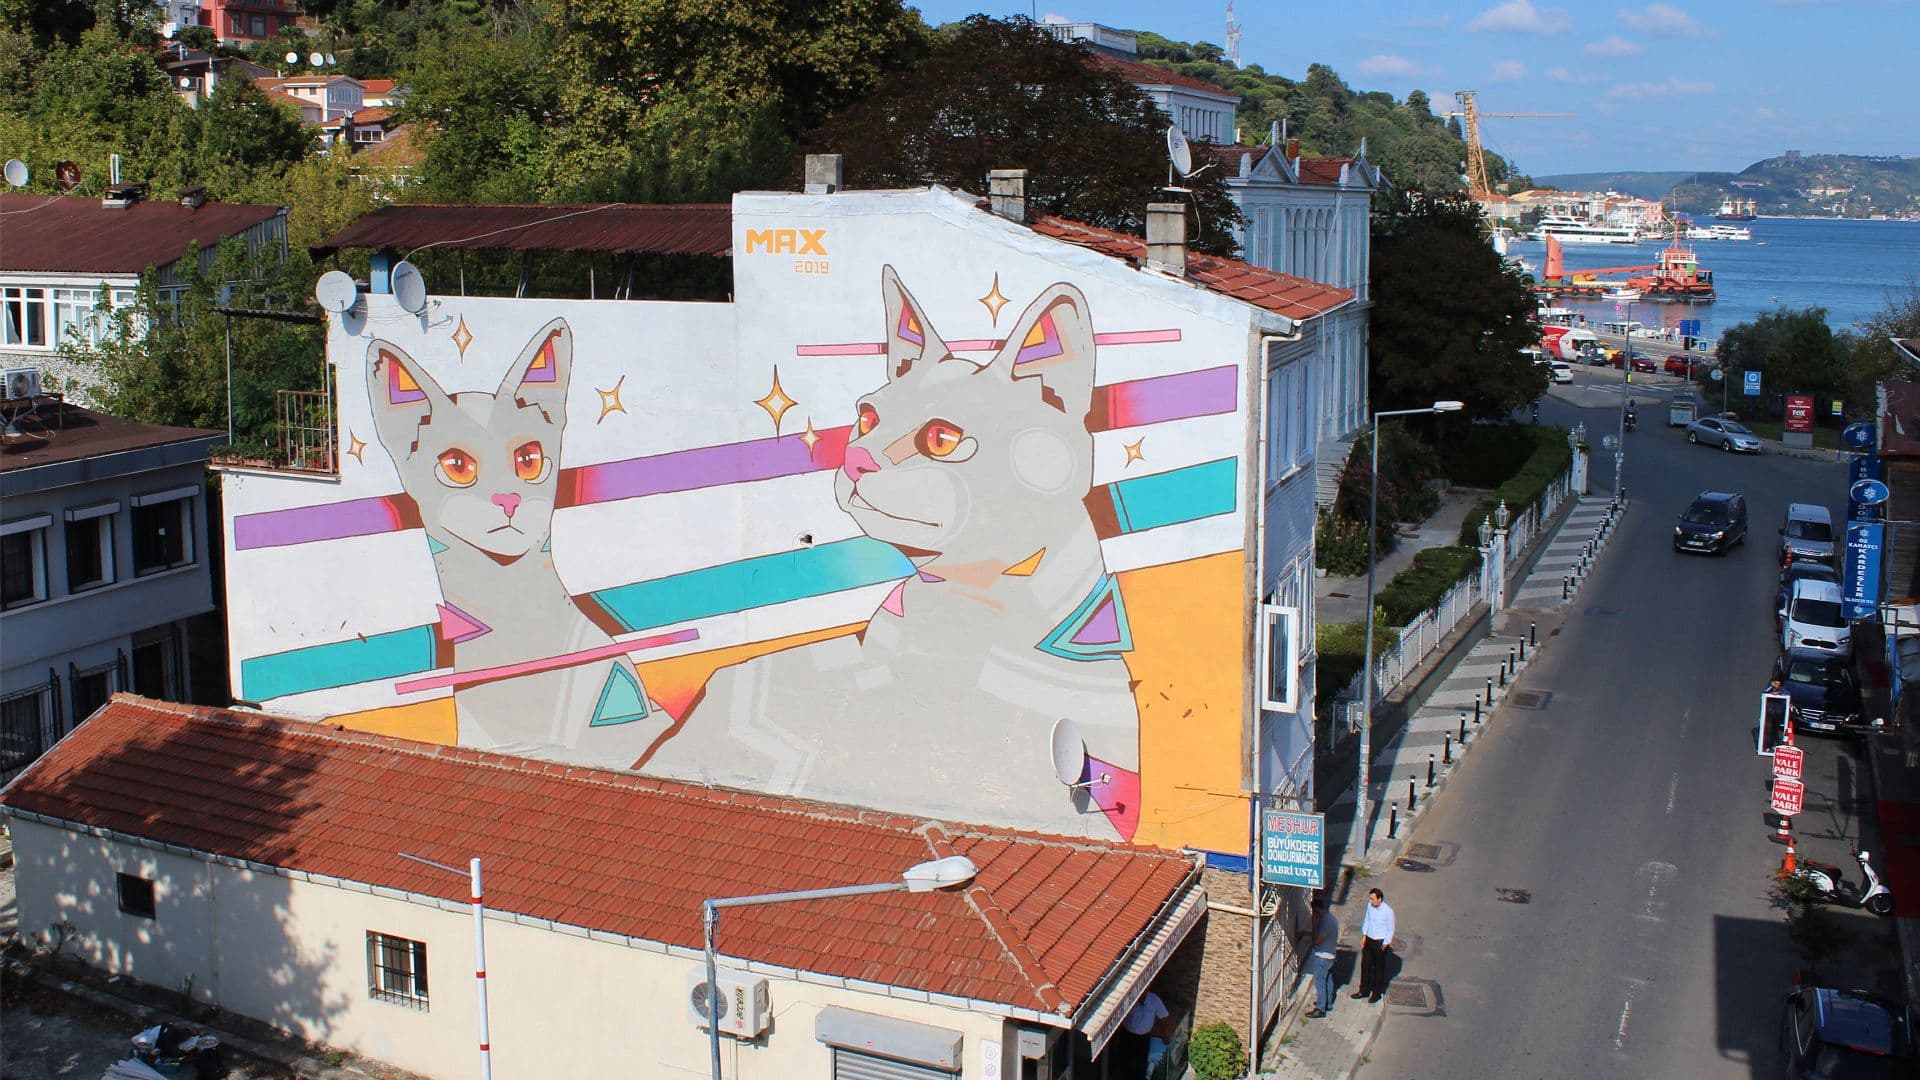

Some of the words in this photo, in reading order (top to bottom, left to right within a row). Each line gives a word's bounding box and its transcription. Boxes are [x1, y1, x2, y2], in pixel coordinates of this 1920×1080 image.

[745, 228, 828, 255] MAX
[795, 260, 829, 274] 2018
[1776, 758, 1799, 769] VALE
[1774, 766, 1799, 776] PARK
[1774, 791, 1799, 802] VALE
[1772, 799, 1799, 811] PARK
[1267, 816, 1320, 838] MEŞHUR
[1267, 835, 1319, 853] BÜYÜKDERE
[1267, 849, 1319, 865] DONDURMACISI
[1266, 864, 1294, 875] SABRİ
[1295, 867, 1319, 878] USTA
